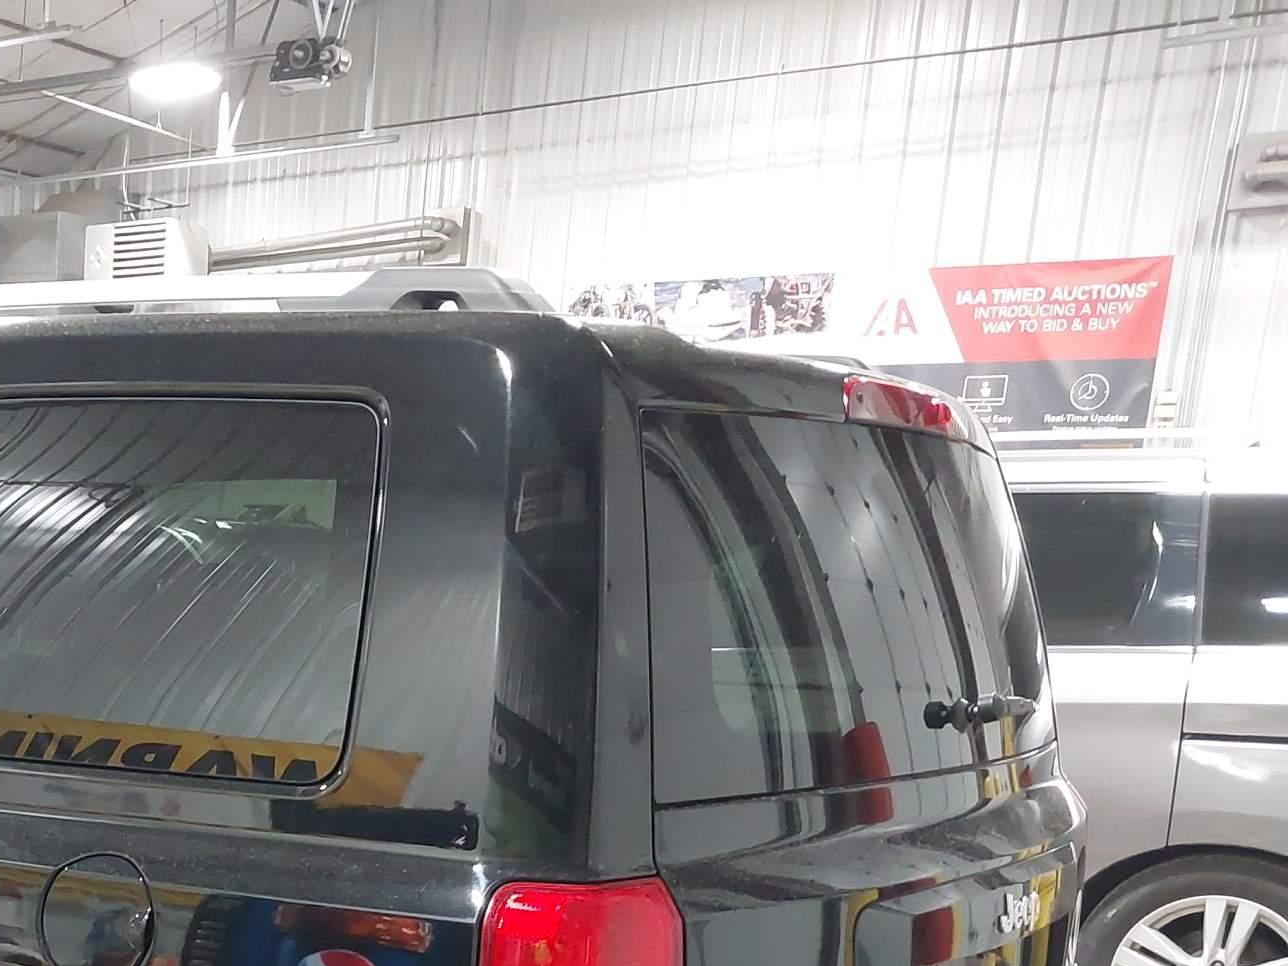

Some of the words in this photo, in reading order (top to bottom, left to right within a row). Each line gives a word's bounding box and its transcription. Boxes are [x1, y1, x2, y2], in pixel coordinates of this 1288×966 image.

[955, 289, 987, 305] IAA
[991, 287, 1046, 304] TIMED
[974, 303, 1076, 320] INTRODUCING
[1079, 303, 1092, 316] A
[1095, 301, 1134, 315] NEW
[982, 320, 1014, 335] WAY
[1019, 319, 1038, 333] TO
[1042, 318, 1067, 333] BID
[1071, 318, 1083, 331] &
[1088, 317, 1121, 331] BUY
[993, 414, 1014, 424] Easy
[1044, 414, 1088, 423] Real-Time
[1091, 414, 1129, 425] Updates
[999, 891, 1040, 933] Jeep
